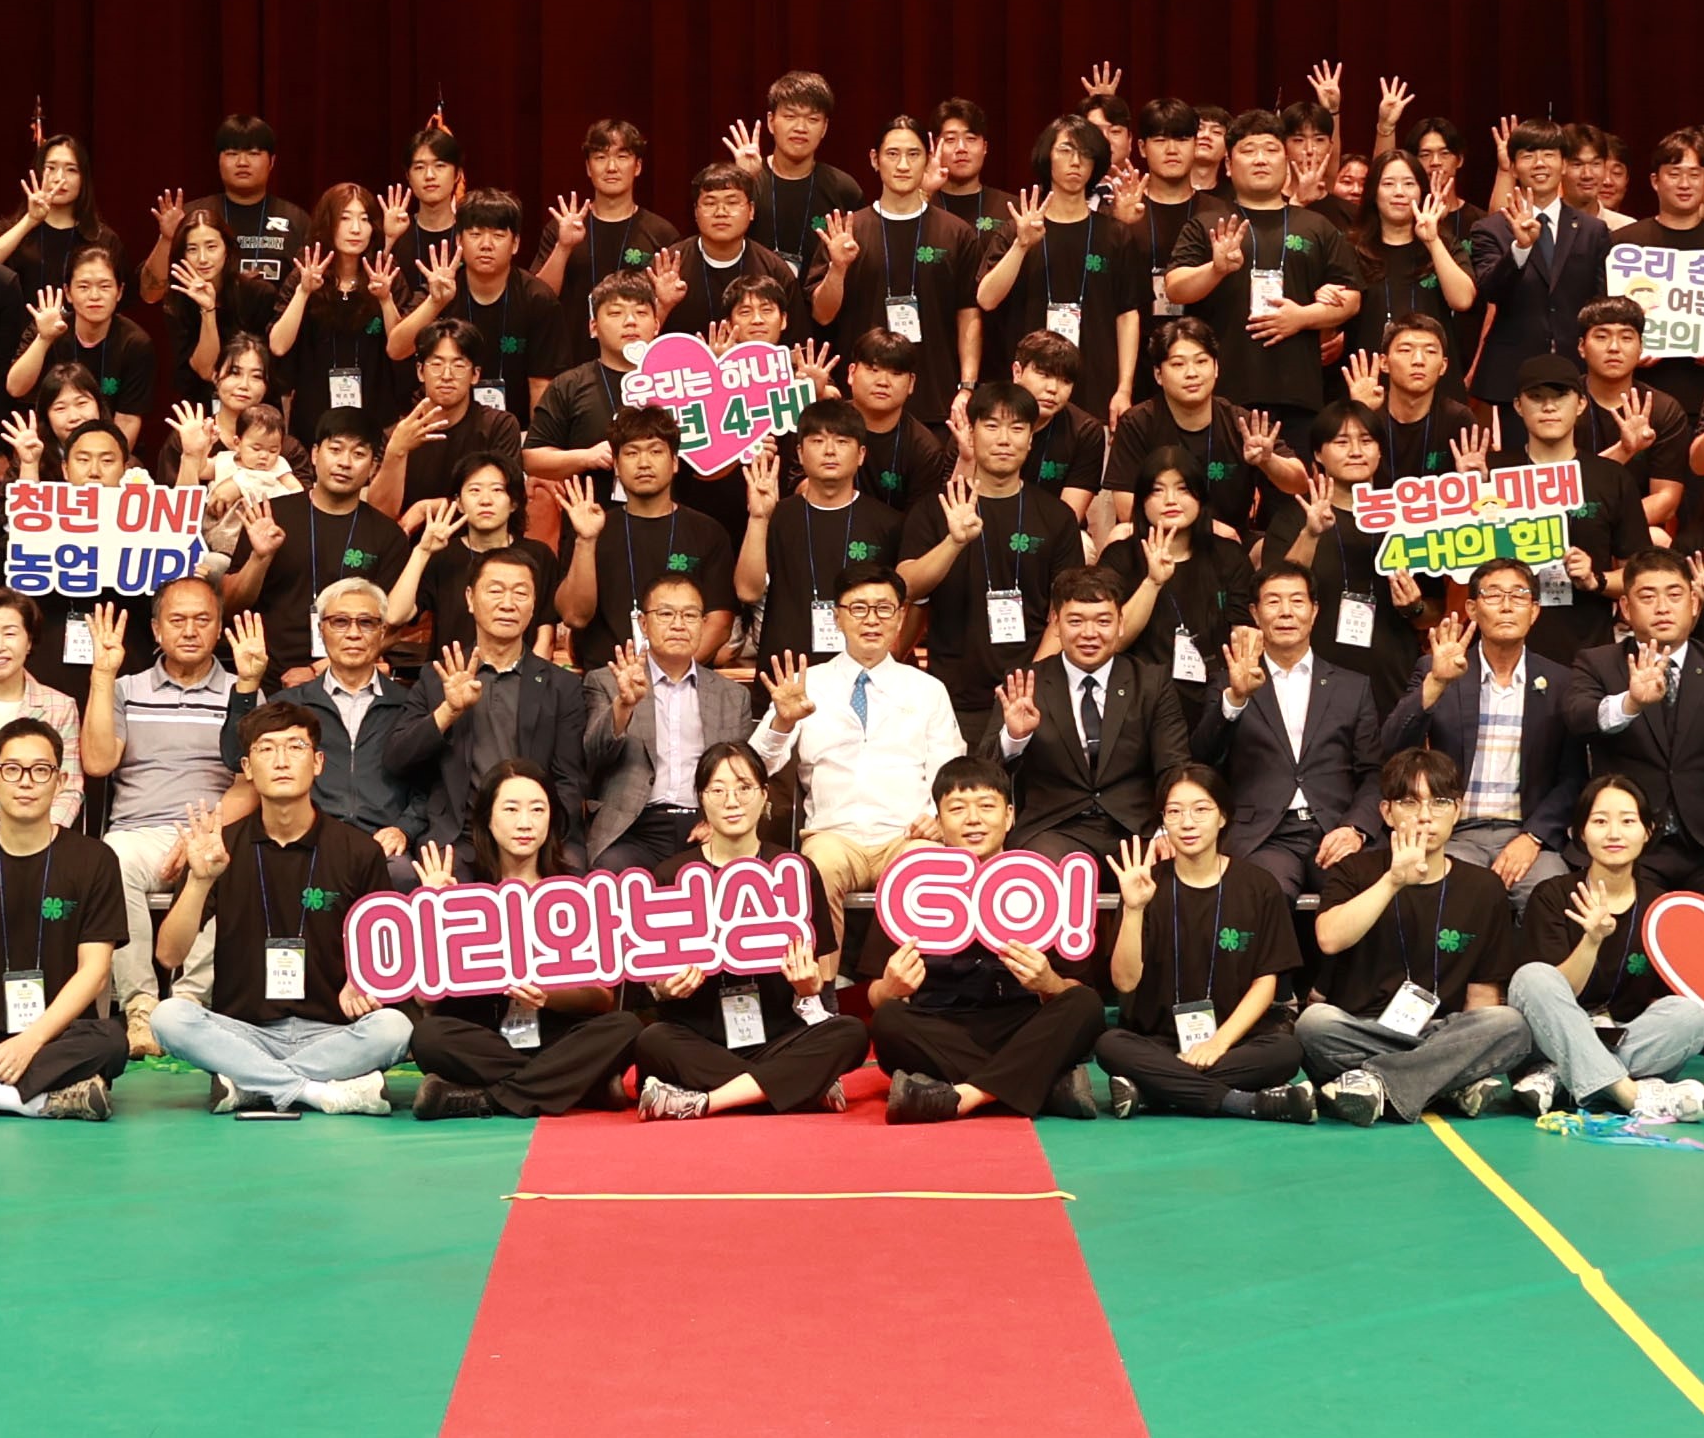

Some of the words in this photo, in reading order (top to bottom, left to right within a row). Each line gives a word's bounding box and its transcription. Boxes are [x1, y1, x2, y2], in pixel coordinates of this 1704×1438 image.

[1612, 247, 1674, 282] 우리
[1641, 320, 1701, 354] 업의
[625, 367, 712, 405] 우리는
[719, 350, 789, 388] 하나!
[669, 402, 709, 449] 년
[9, 483, 99, 533] 청년
[116, 483, 202, 535] ON!
[1355, 474, 1481, 530] 농업의
[1495, 465, 1580, 510] 미래
[8, 543, 99, 592] 농업
[1381, 524, 1495, 571] 4-H의
[1510, 517, 1564, 563] 힘!
[352, 857, 813, 999] 이리와보성
[882, 853, 1094, 956] GO!
